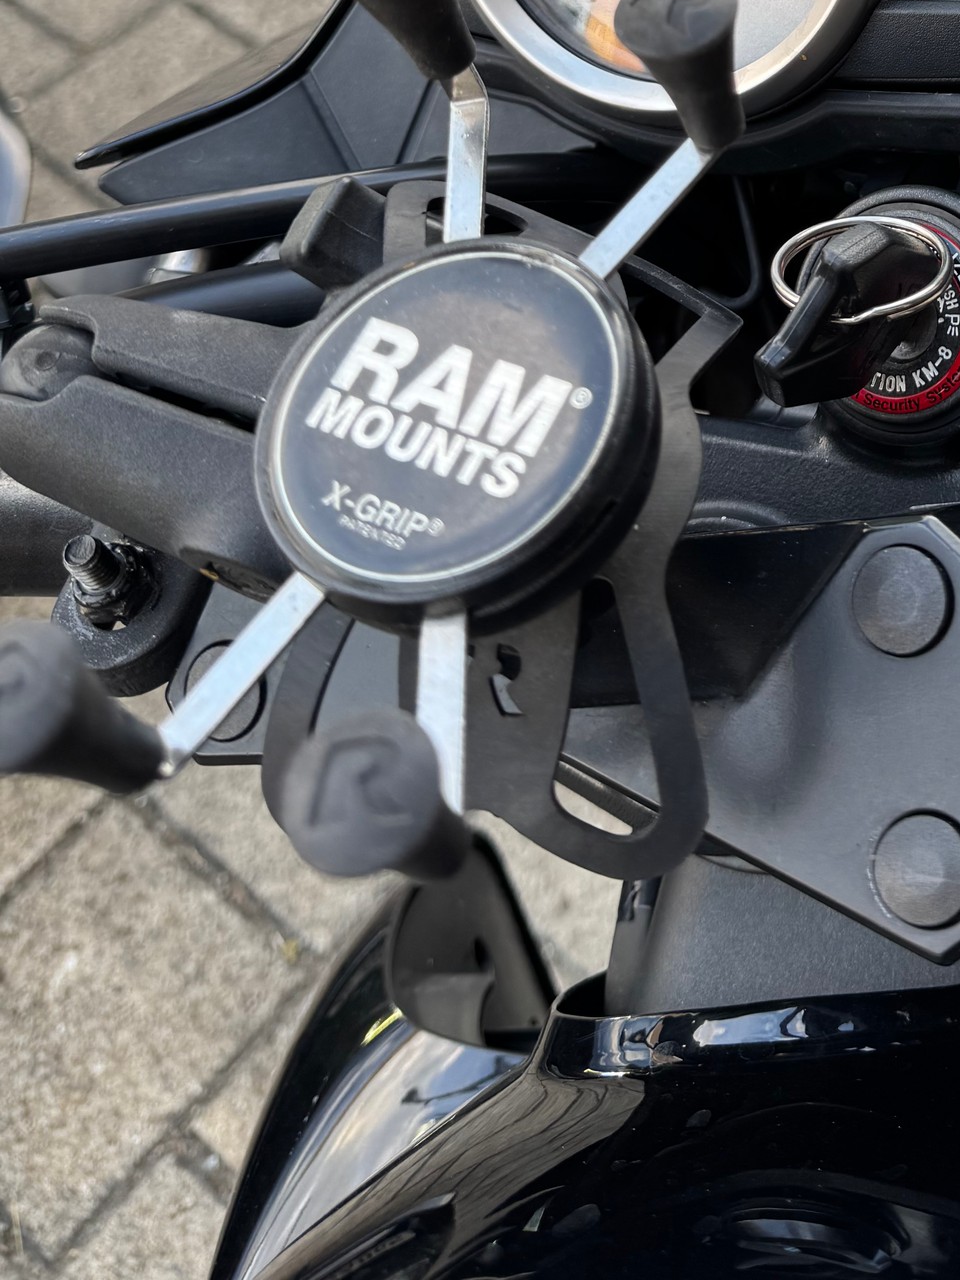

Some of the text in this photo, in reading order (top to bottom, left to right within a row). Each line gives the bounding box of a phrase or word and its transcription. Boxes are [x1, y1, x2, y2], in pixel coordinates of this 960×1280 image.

[912, 345, 953, 388] KM-8
[862, 391, 922, 412] Security
[304, 387, 528, 499] MOUNTS
